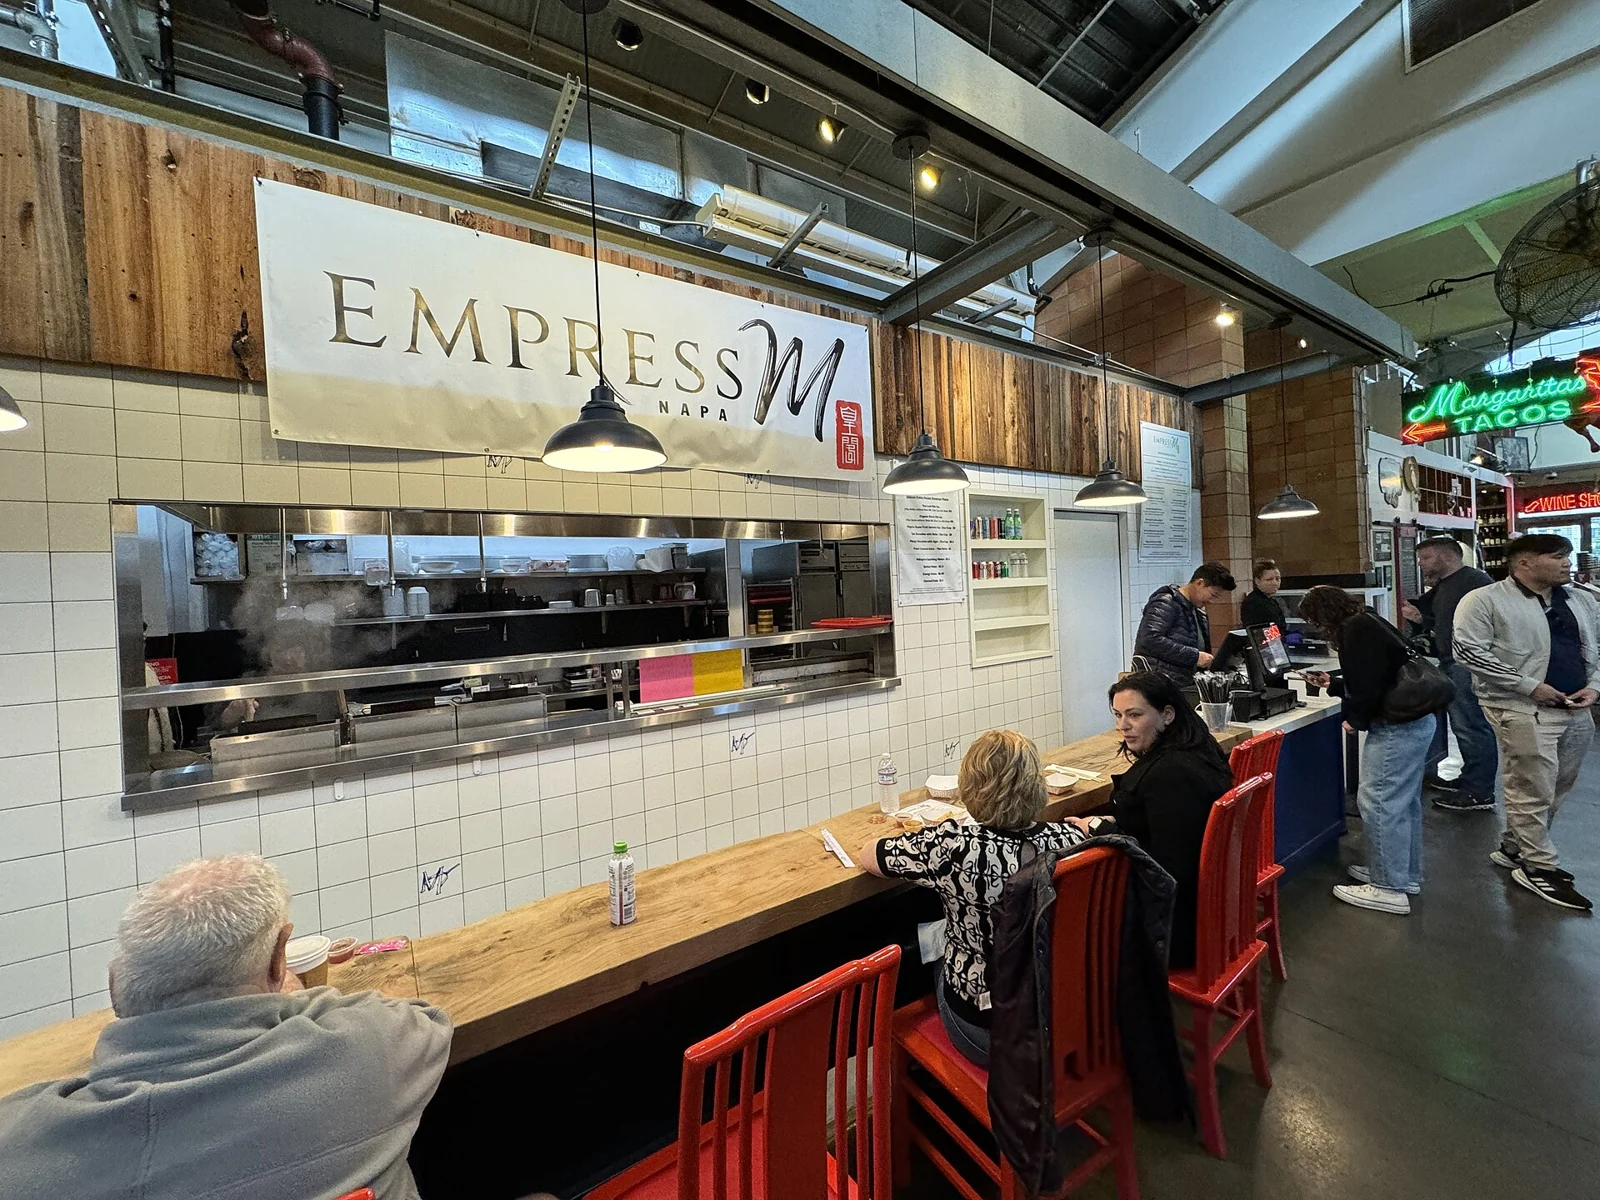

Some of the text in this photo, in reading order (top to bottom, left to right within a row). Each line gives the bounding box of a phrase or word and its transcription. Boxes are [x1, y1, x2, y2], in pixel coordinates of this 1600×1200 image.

[323, 269, 845, 443] EMPRESS M
[658, 400, 728, 421] NAPA
[1407, 374, 1587, 423] Margaritas
[1453, 400, 1572, 434] TACOS
[1539, 494, 1577, 511] WINE
